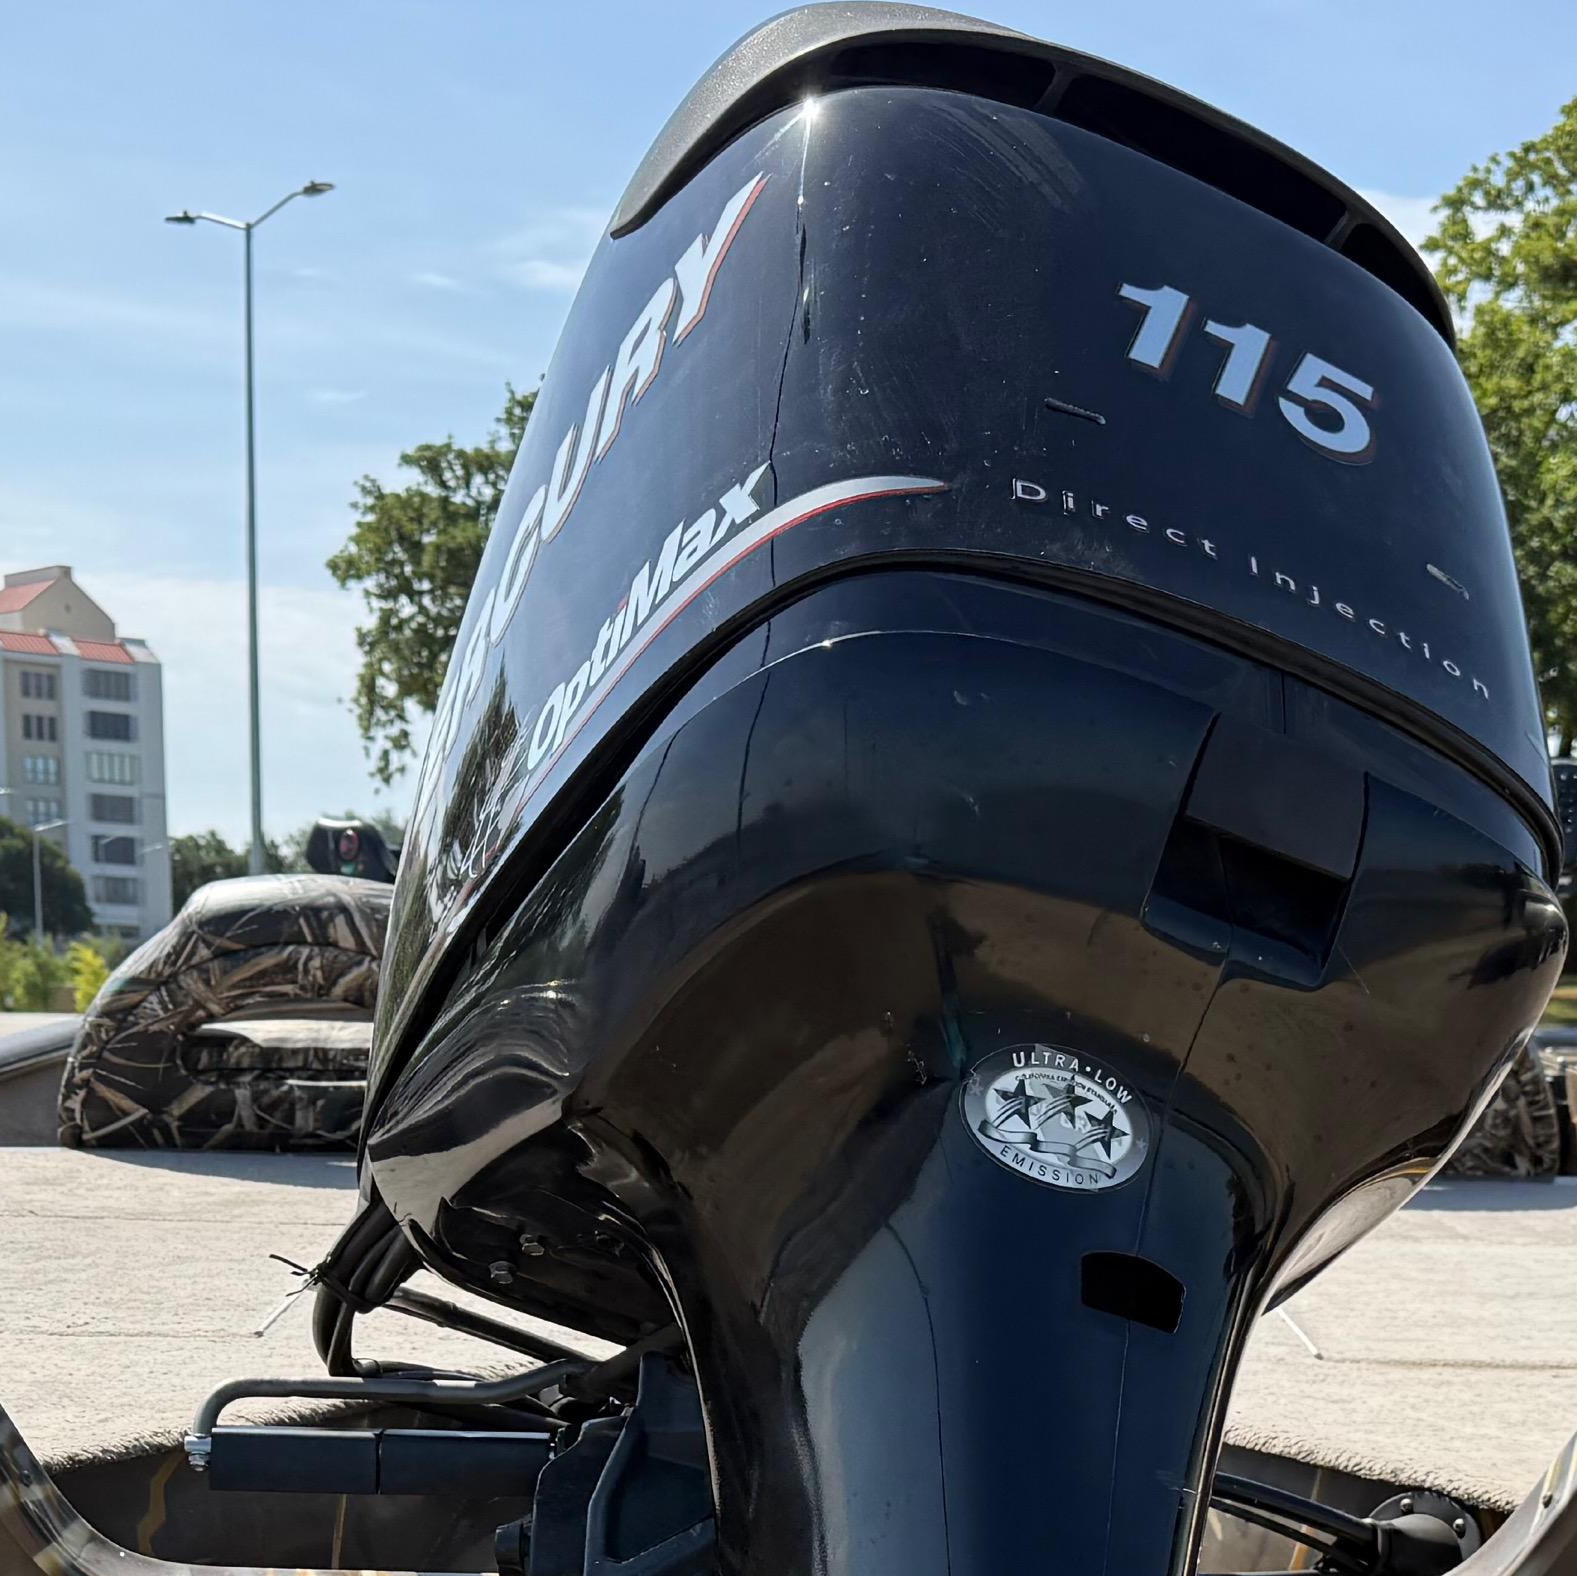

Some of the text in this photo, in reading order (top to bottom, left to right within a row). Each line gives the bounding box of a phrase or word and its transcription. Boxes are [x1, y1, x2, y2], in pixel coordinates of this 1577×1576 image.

[1116, 281, 1376, 462] 115
[526, 461, 771, 771] OptiMax
[1011, 477, 1490, 700] Direct Injection
[999, 1145, 1099, 1184] EMISSION
[1012, 1051, 1133, 1104] ULTRA LOW
